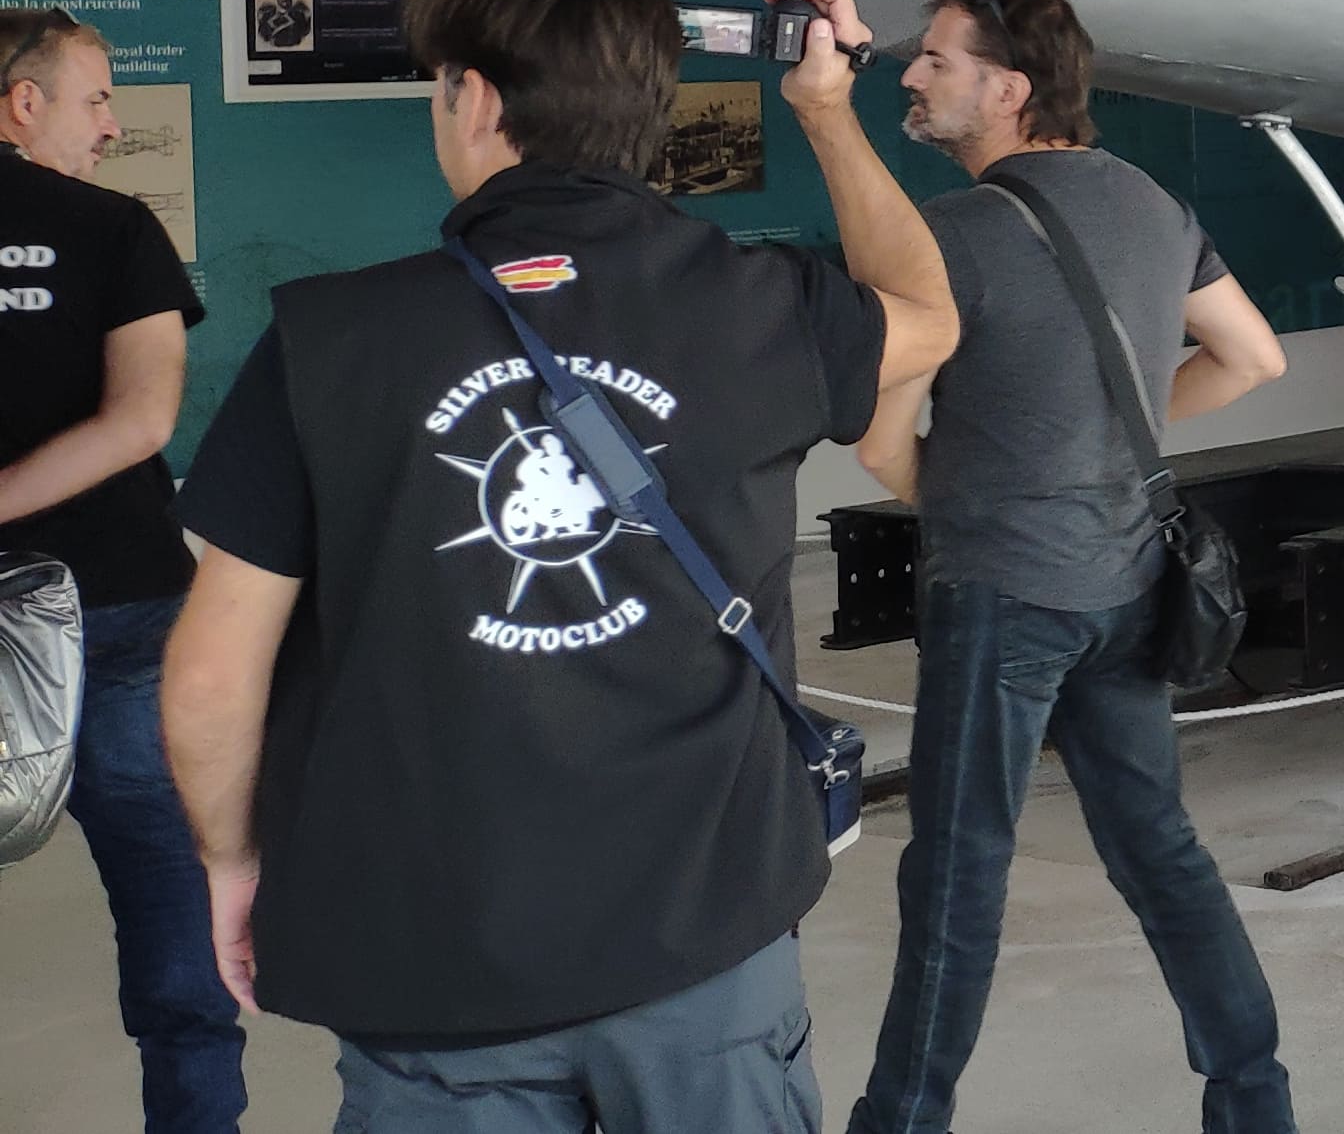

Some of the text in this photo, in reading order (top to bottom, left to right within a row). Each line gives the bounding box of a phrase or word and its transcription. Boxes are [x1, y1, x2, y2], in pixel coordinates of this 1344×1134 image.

[113, 60, 170, 74] building
[425, 355, 678, 433] SILVER EADER
[468, 597, 647, 652] MOTOCLUB
